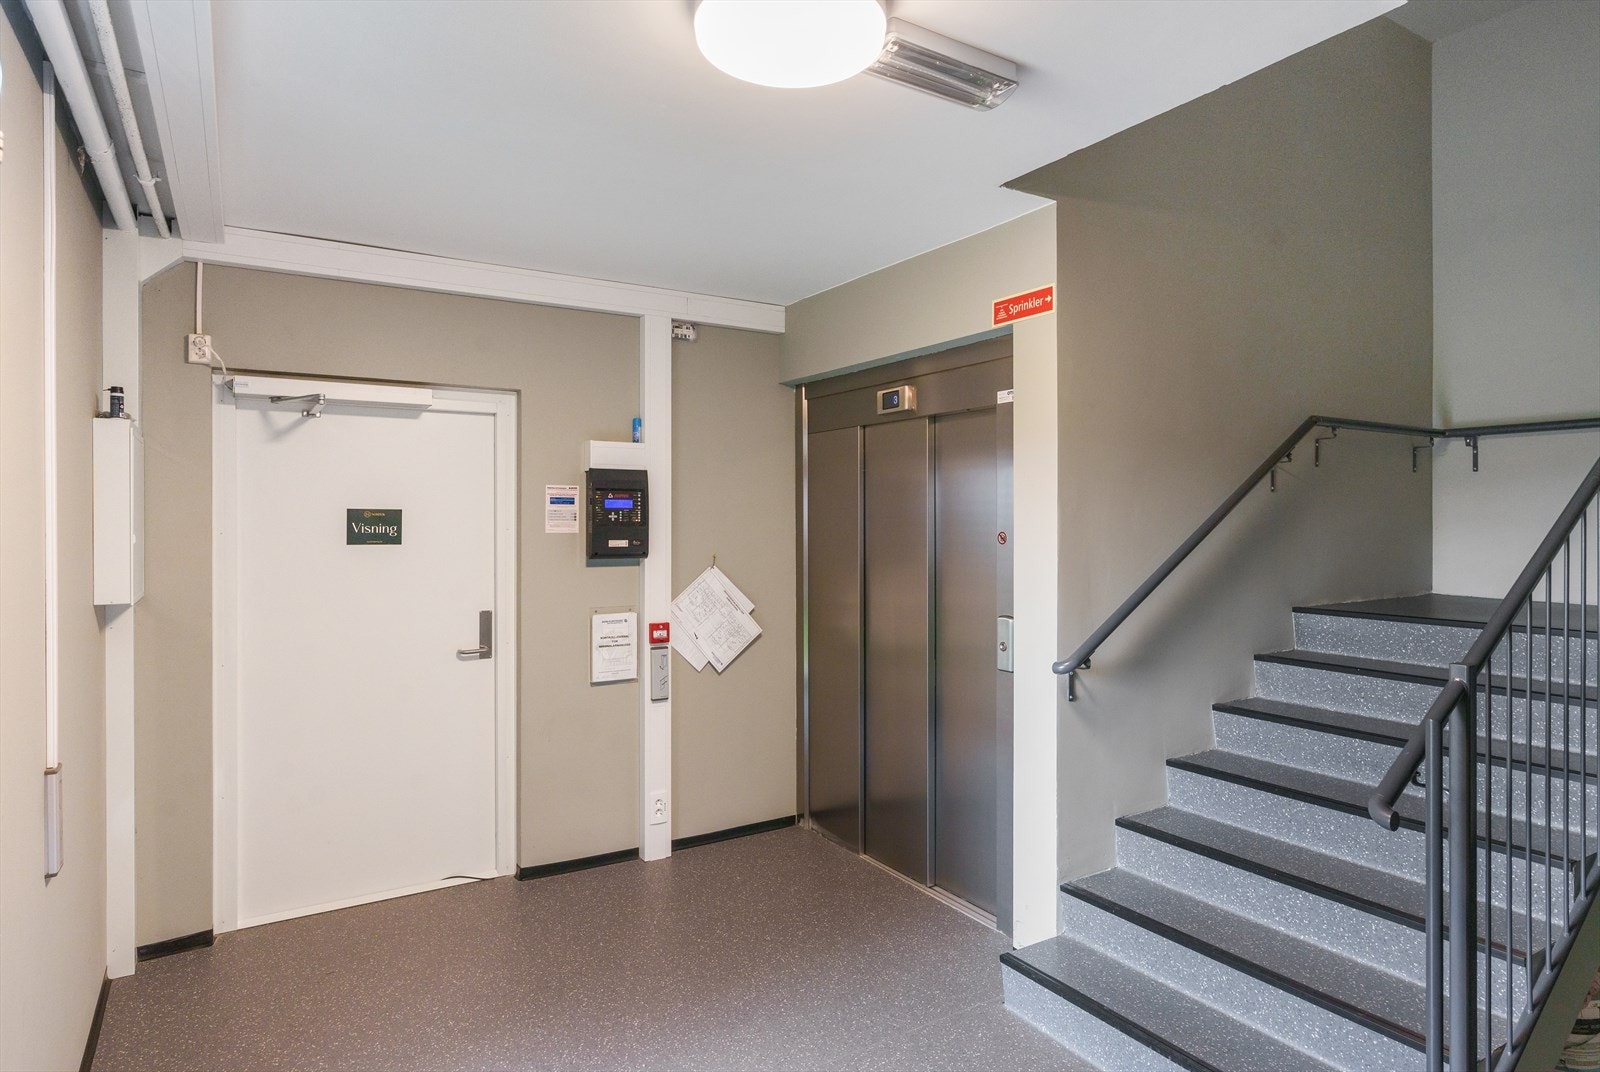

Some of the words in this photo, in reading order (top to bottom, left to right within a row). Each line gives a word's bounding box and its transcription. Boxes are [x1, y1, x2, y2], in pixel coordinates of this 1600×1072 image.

[1009, 297, 1044, 315] Sprinkler
[893, 395, 898, 405] 3
[352, 522, 398, 536] Visning
